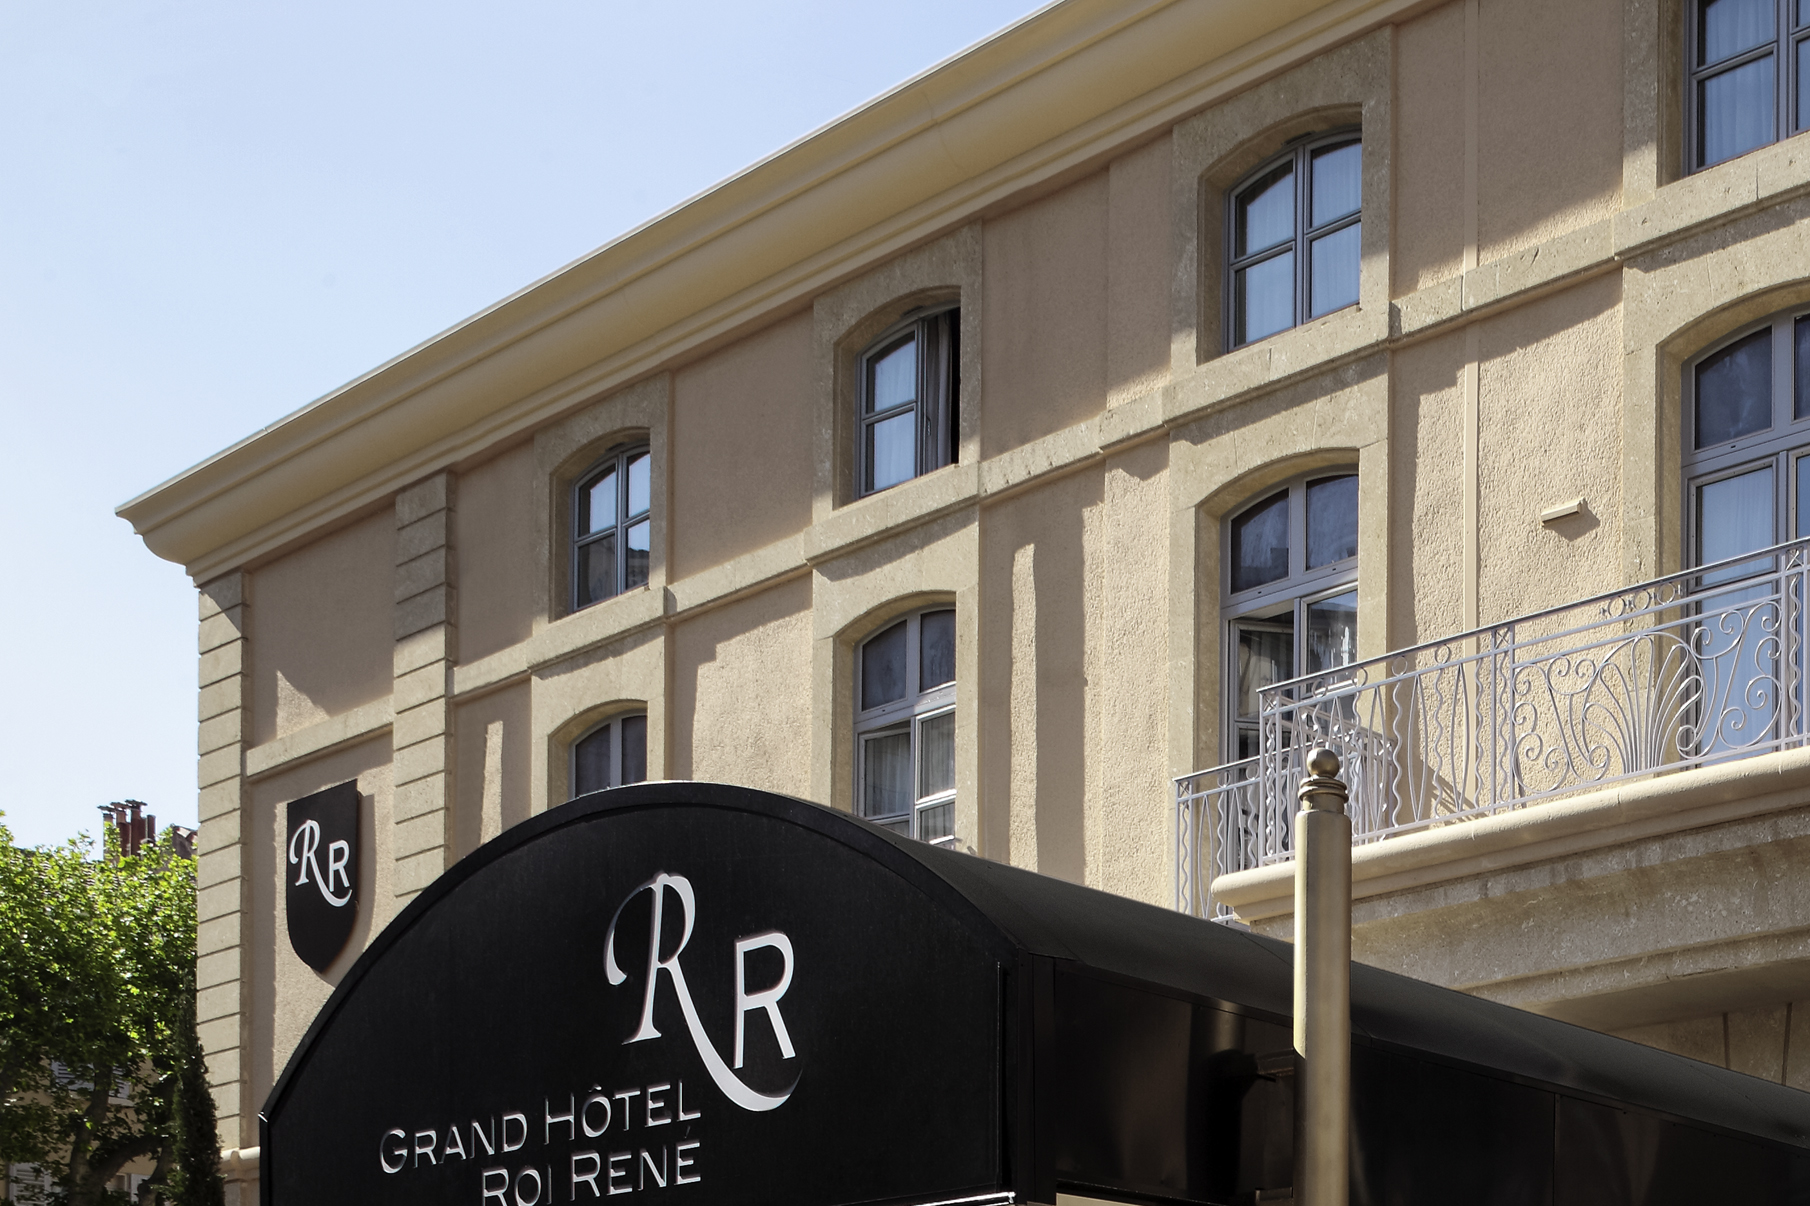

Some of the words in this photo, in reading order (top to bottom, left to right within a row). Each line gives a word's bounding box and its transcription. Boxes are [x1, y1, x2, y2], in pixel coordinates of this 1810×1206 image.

[289, 819, 352, 907] RR
[604, 873, 803, 1112] RR
[380, 1114, 528, 1174] GRAND
[544, 1080, 701, 1145] HÔTEL
